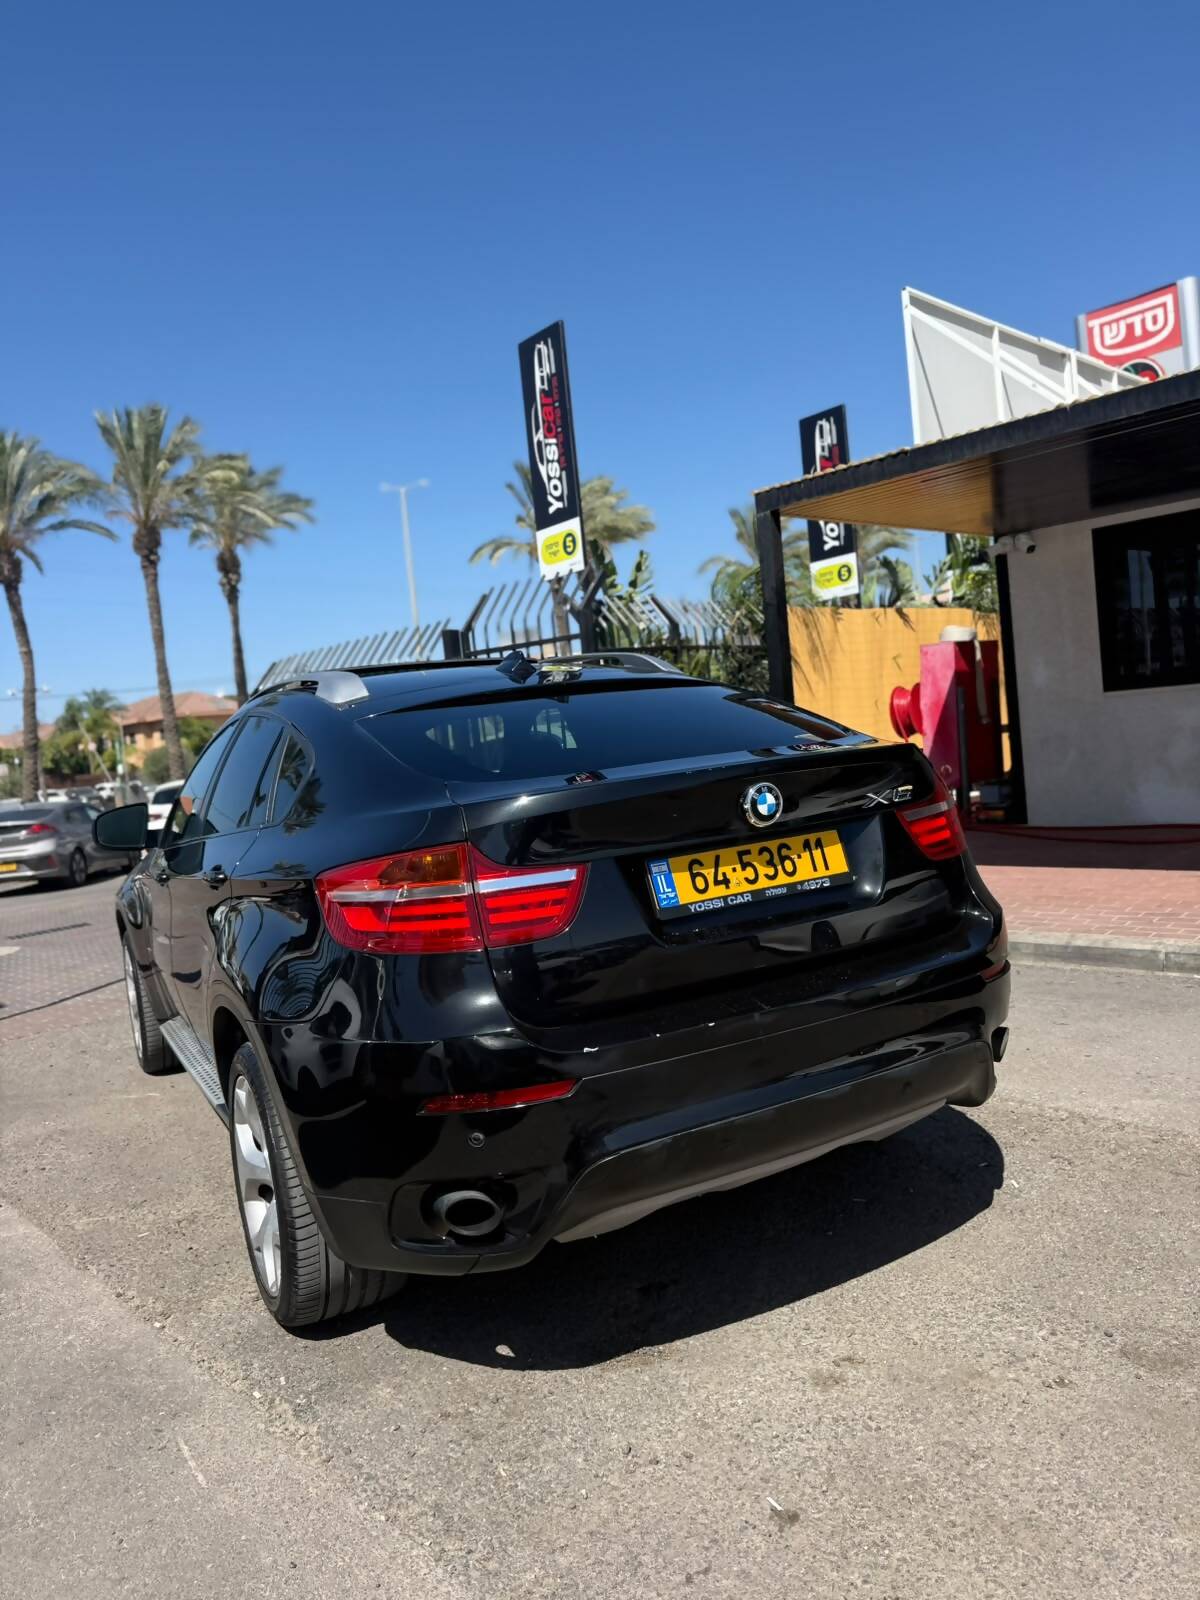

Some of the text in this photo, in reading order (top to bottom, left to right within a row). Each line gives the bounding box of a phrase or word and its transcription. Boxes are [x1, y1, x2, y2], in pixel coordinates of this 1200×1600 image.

[657, 875, 672, 893] IL
[688, 899, 725, 912] YOSSI
[727, 893, 753, 905] CAR
